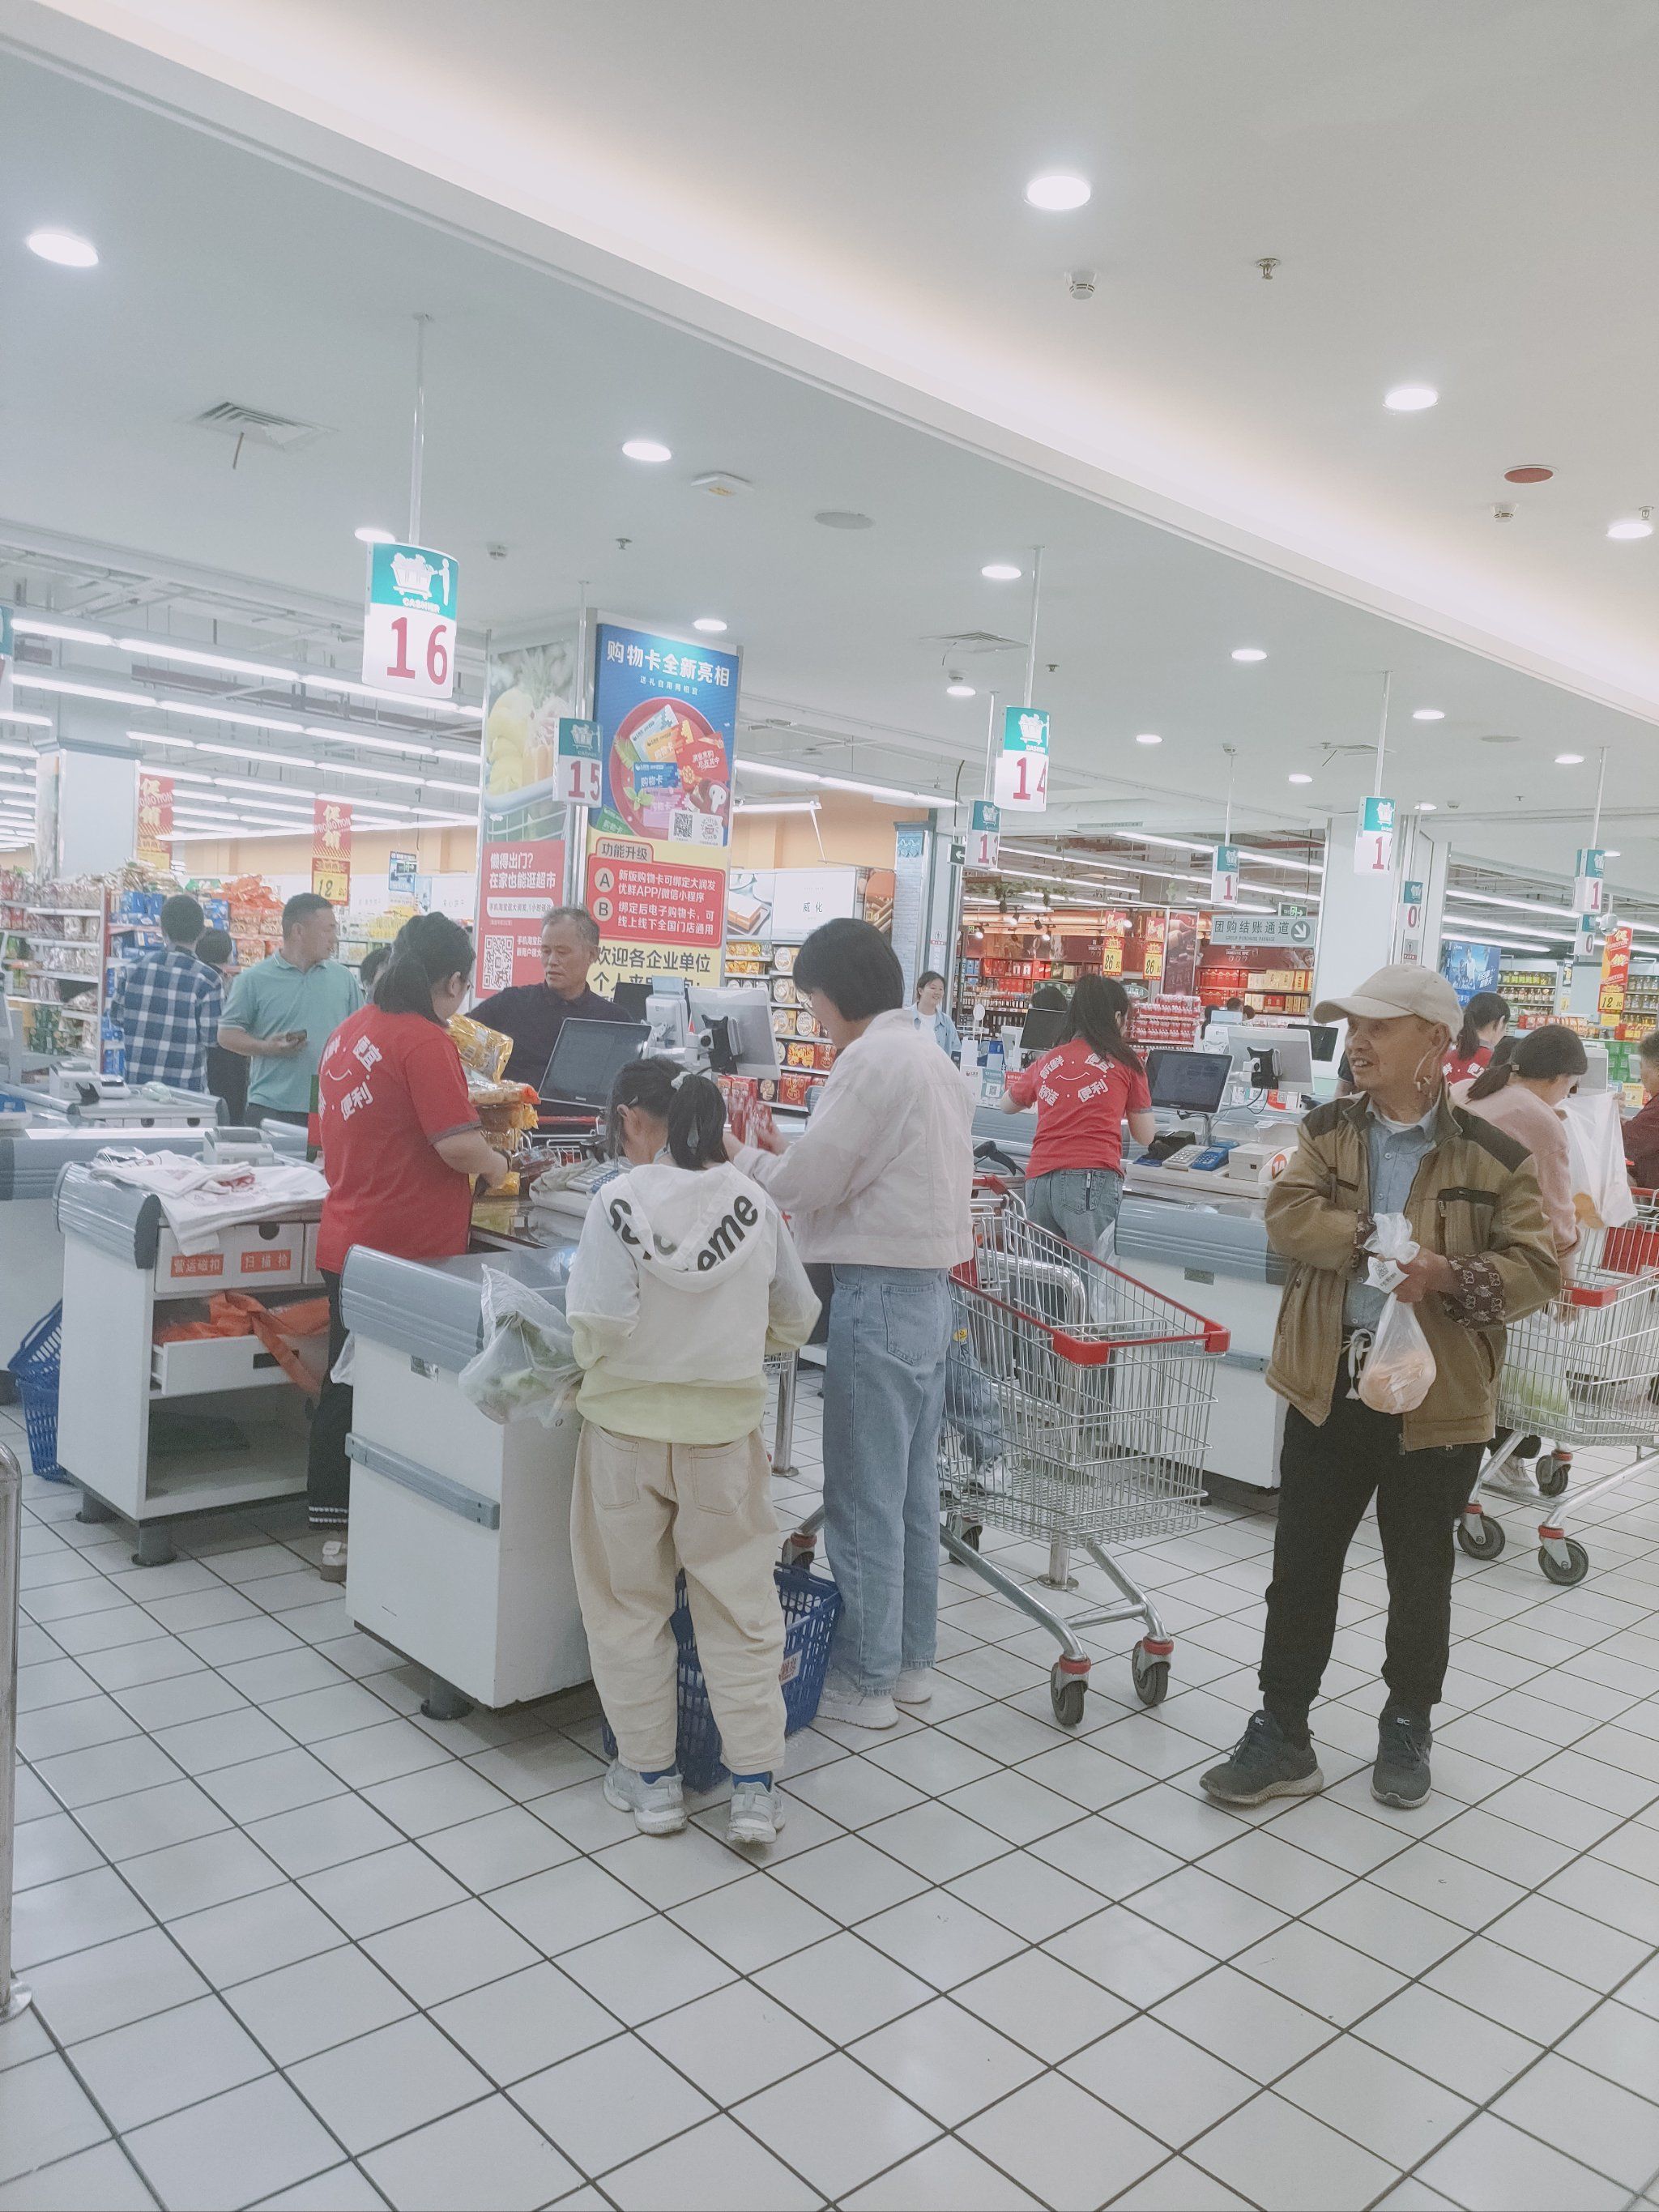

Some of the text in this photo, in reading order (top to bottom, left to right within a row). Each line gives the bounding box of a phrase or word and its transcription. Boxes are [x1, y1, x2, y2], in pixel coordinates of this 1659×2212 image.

[387, 617, 447, 685] 16
[607, 640, 731, 687] 购物卡全新亮相
[568, 761, 601, 801] 15
[640, 774, 664, 788] 购物卡
[139, 791, 173, 808] OMOTION
[601, 842, 648, 861] 功能升级
[488, 872, 557, 889] 在家也能逛超市
[599, 873, 611, 888] A
[618, 869, 716, 892] 新版购物卡可绑定大润发
[618, 883, 705, 903] 优鲜APP/微信小程序
[599, 902, 608, 916] B
[803, 901, 823, 913] 威化
[617, 916, 714, 936] 线上线下全国门店通用
[1215, 920, 1290, 935] 团购结账通道
[595, 946, 711, 973] 欢迎各企业单位
[1601, 996, 1614, 1008] 12
[352, 1035, 382, 1072] 便宜
[1039, 1055, 1064, 1080] 新鲜
[1038, 1085, 1060, 1106] 舒适
[1077, 1078, 1109, 1103] 便利
[340, 1081, 373, 1121] 便利
